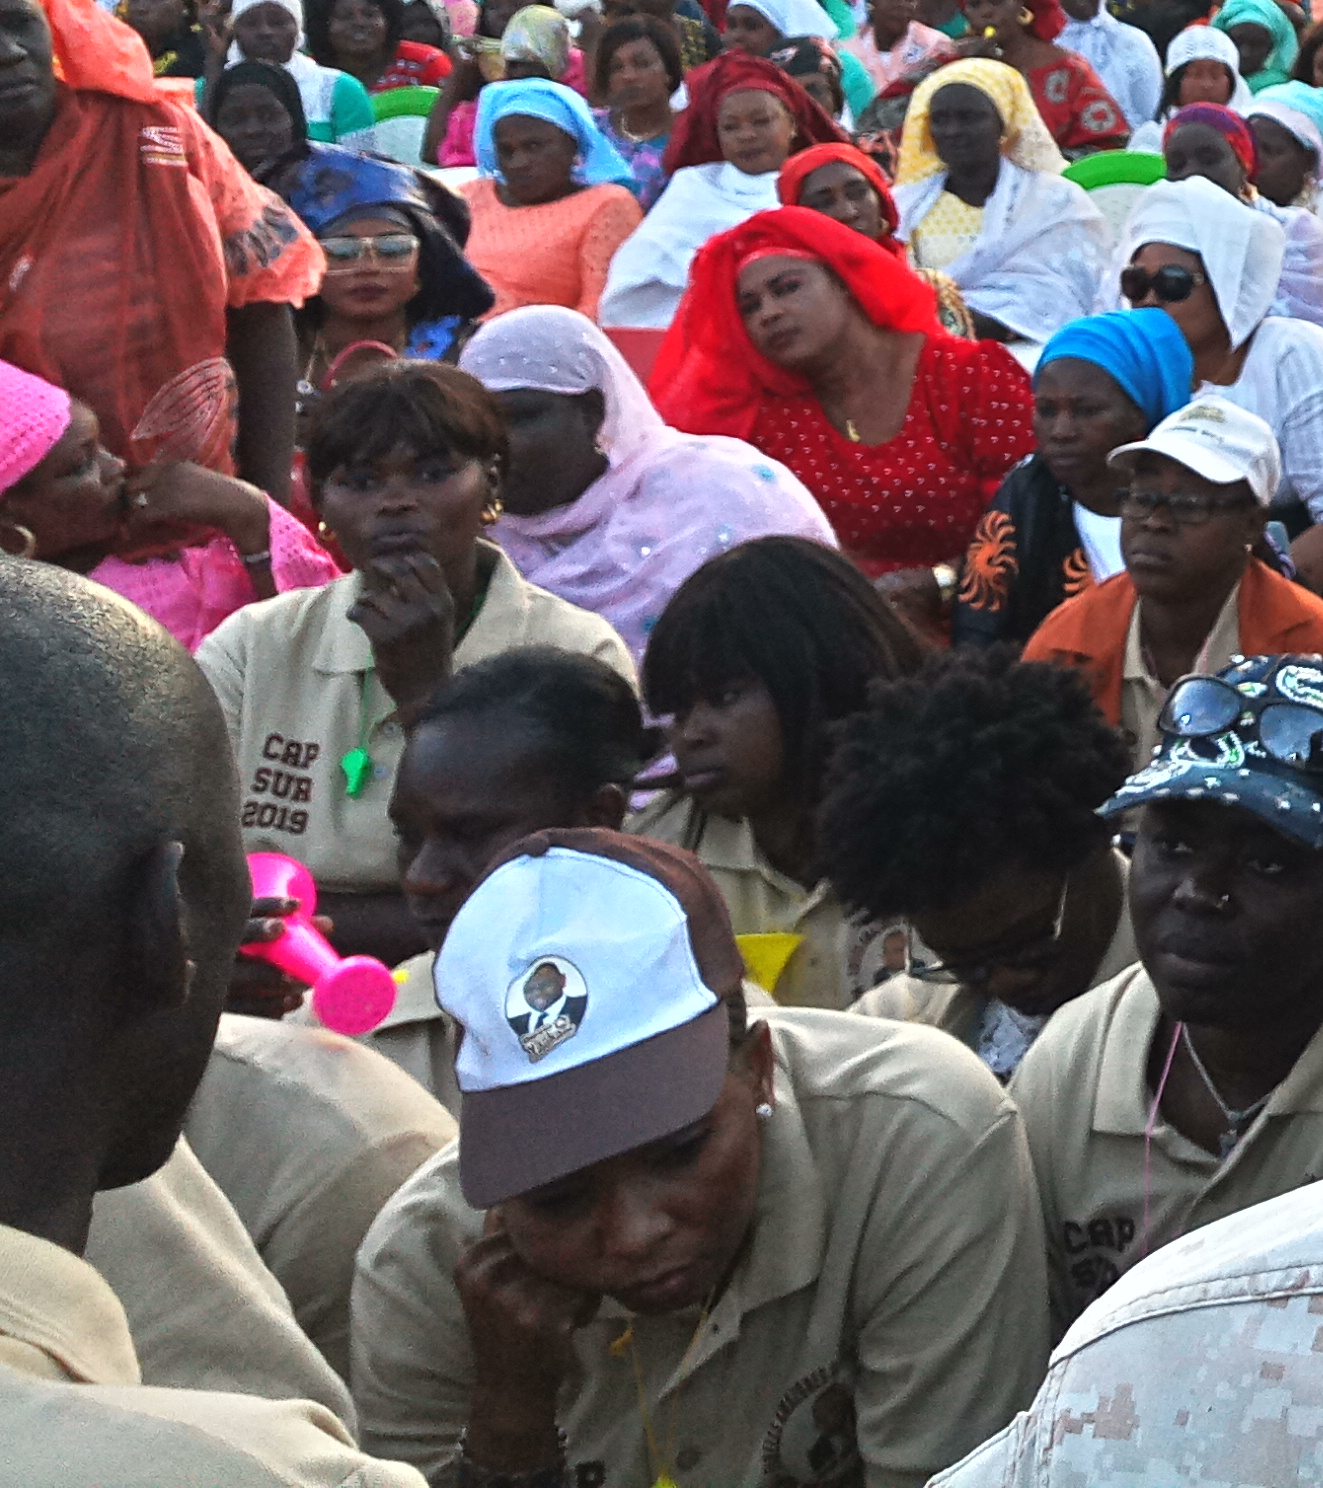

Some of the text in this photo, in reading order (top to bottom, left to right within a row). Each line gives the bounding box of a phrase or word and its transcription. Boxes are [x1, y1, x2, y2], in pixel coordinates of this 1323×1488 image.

[262, 732, 319, 770] CAP
[250, 768, 313, 802] SUR
[240, 800, 310, 835] 2019
[1063, 1216, 1135, 1254] CAP
